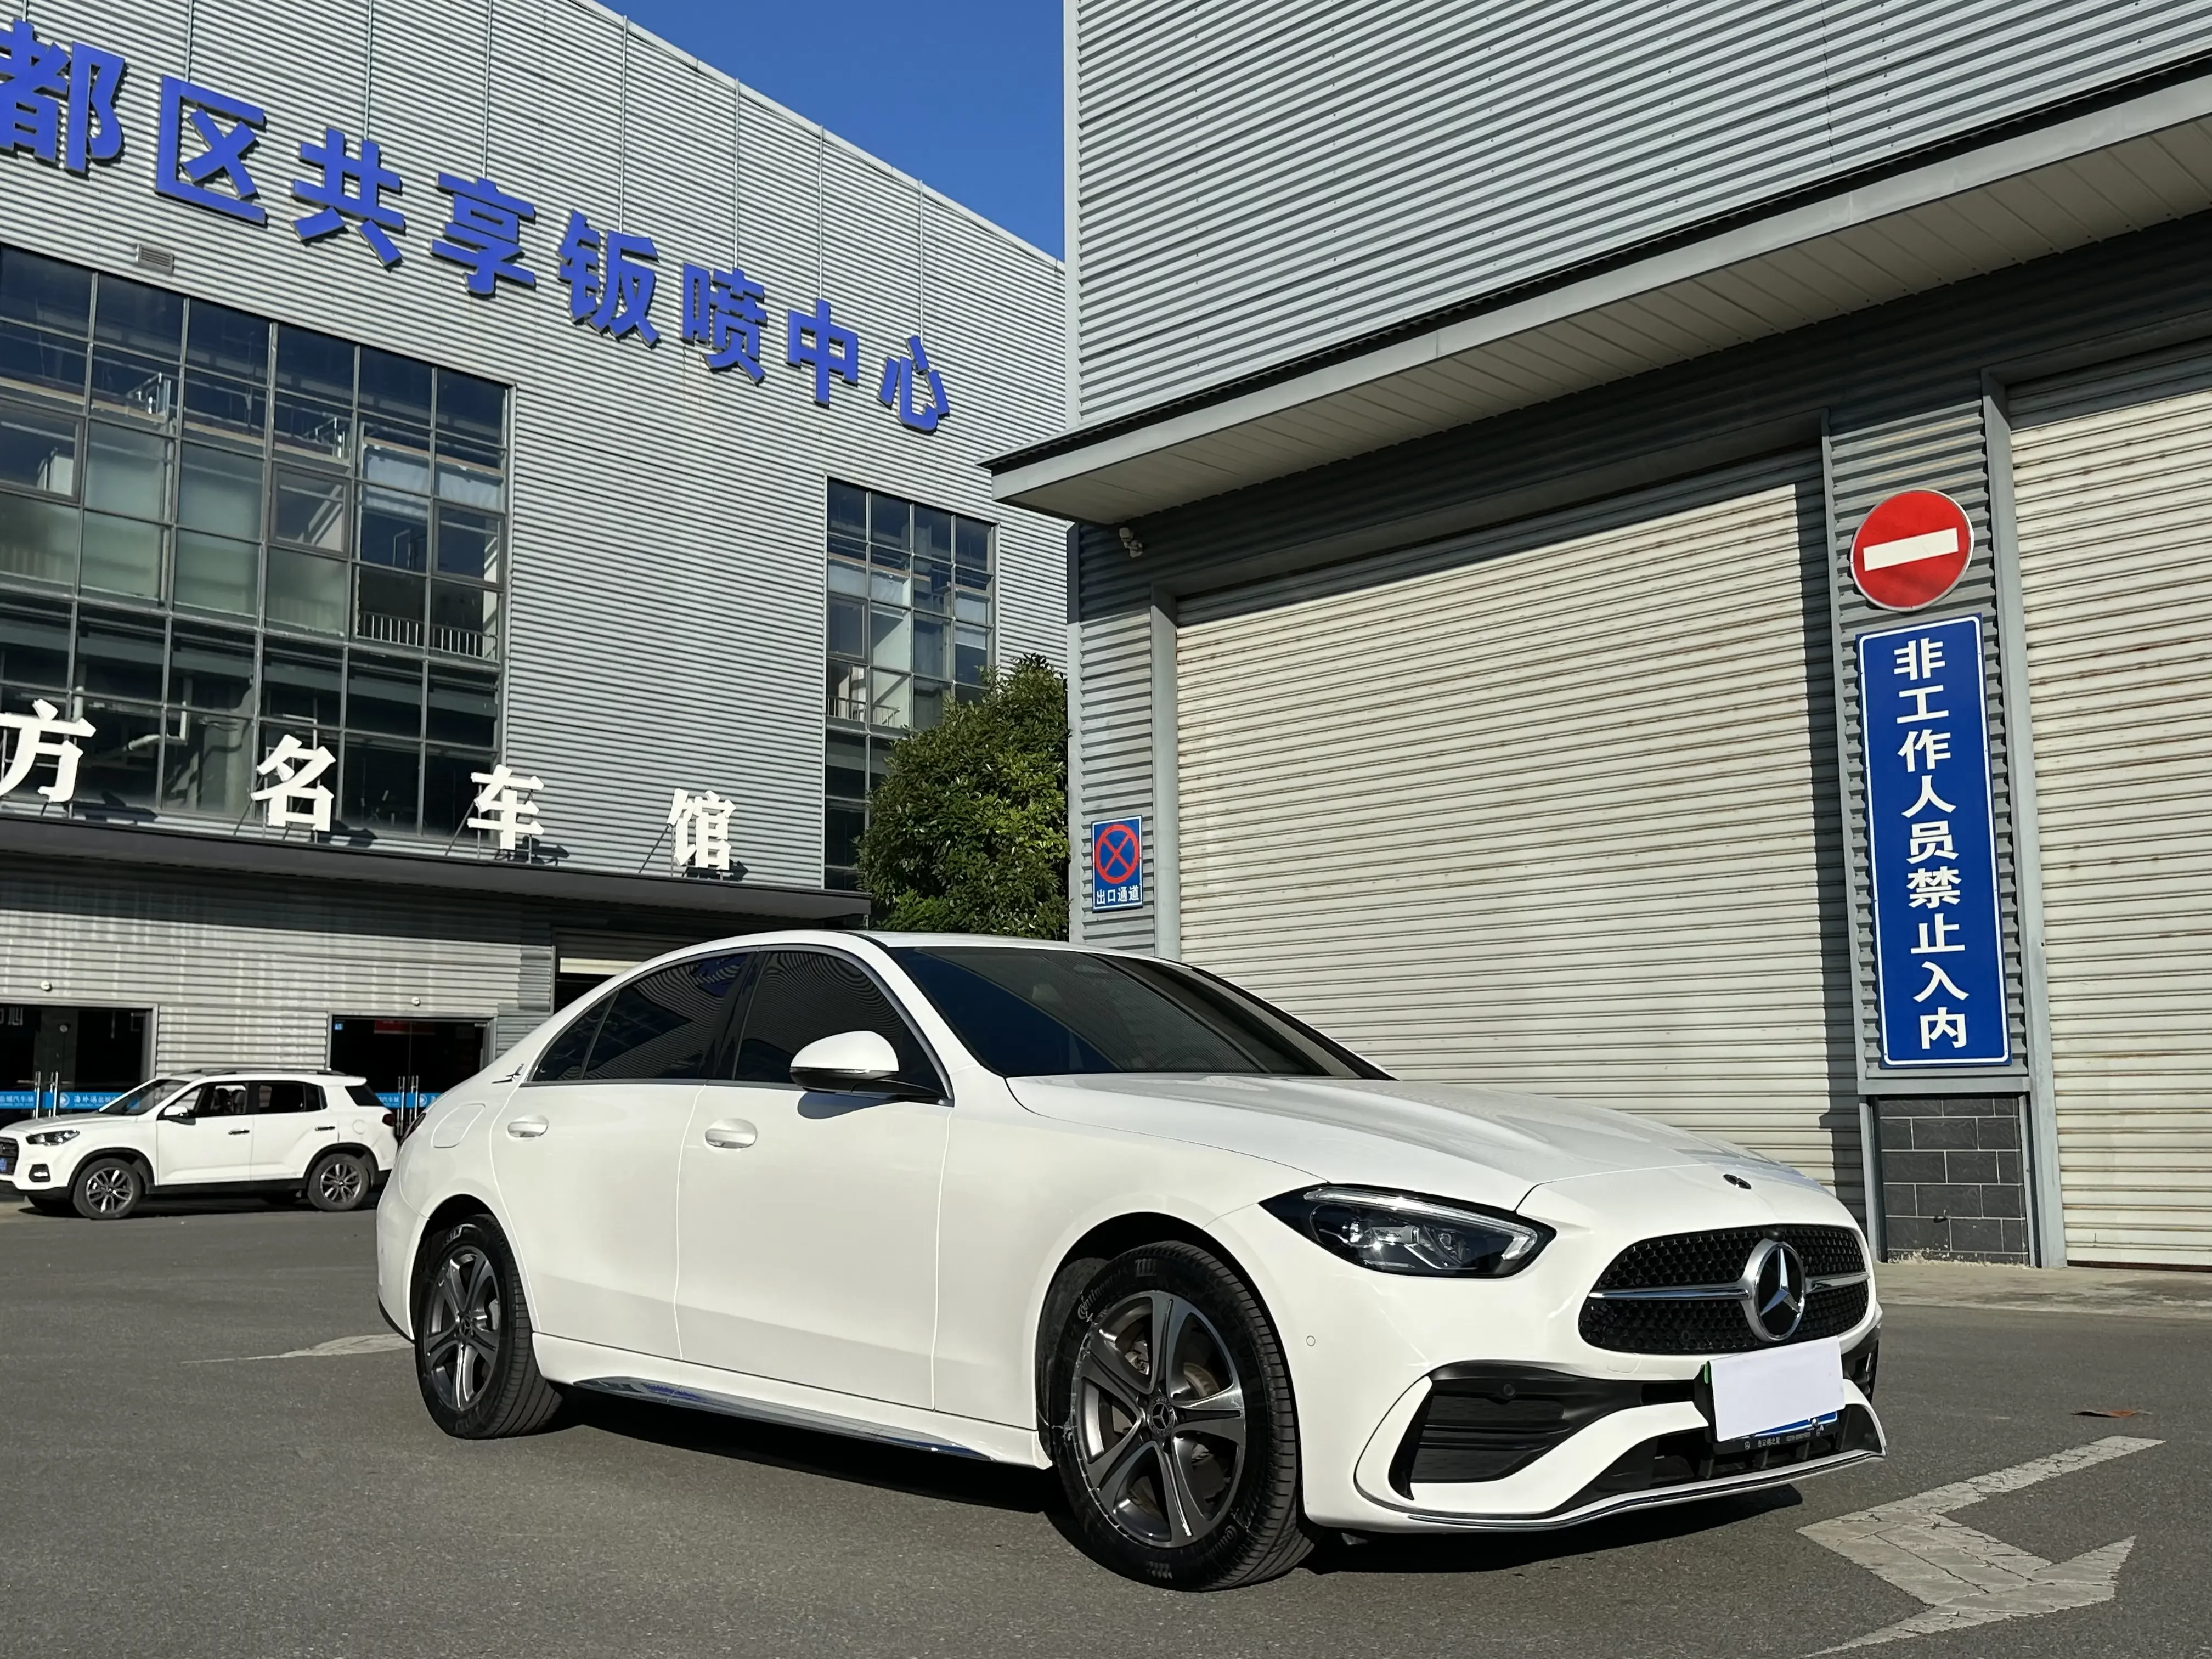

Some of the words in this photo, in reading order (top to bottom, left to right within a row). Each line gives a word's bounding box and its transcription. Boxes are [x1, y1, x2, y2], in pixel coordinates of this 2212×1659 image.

[0, 18, 949, 433] 都区共享钣喷中心
[0, 699, 736, 871] 方名车馆
[1097, 884, 1139, 905] 出口通道
[1894, 637, 1969, 1049] 非工作人员禁止入内
